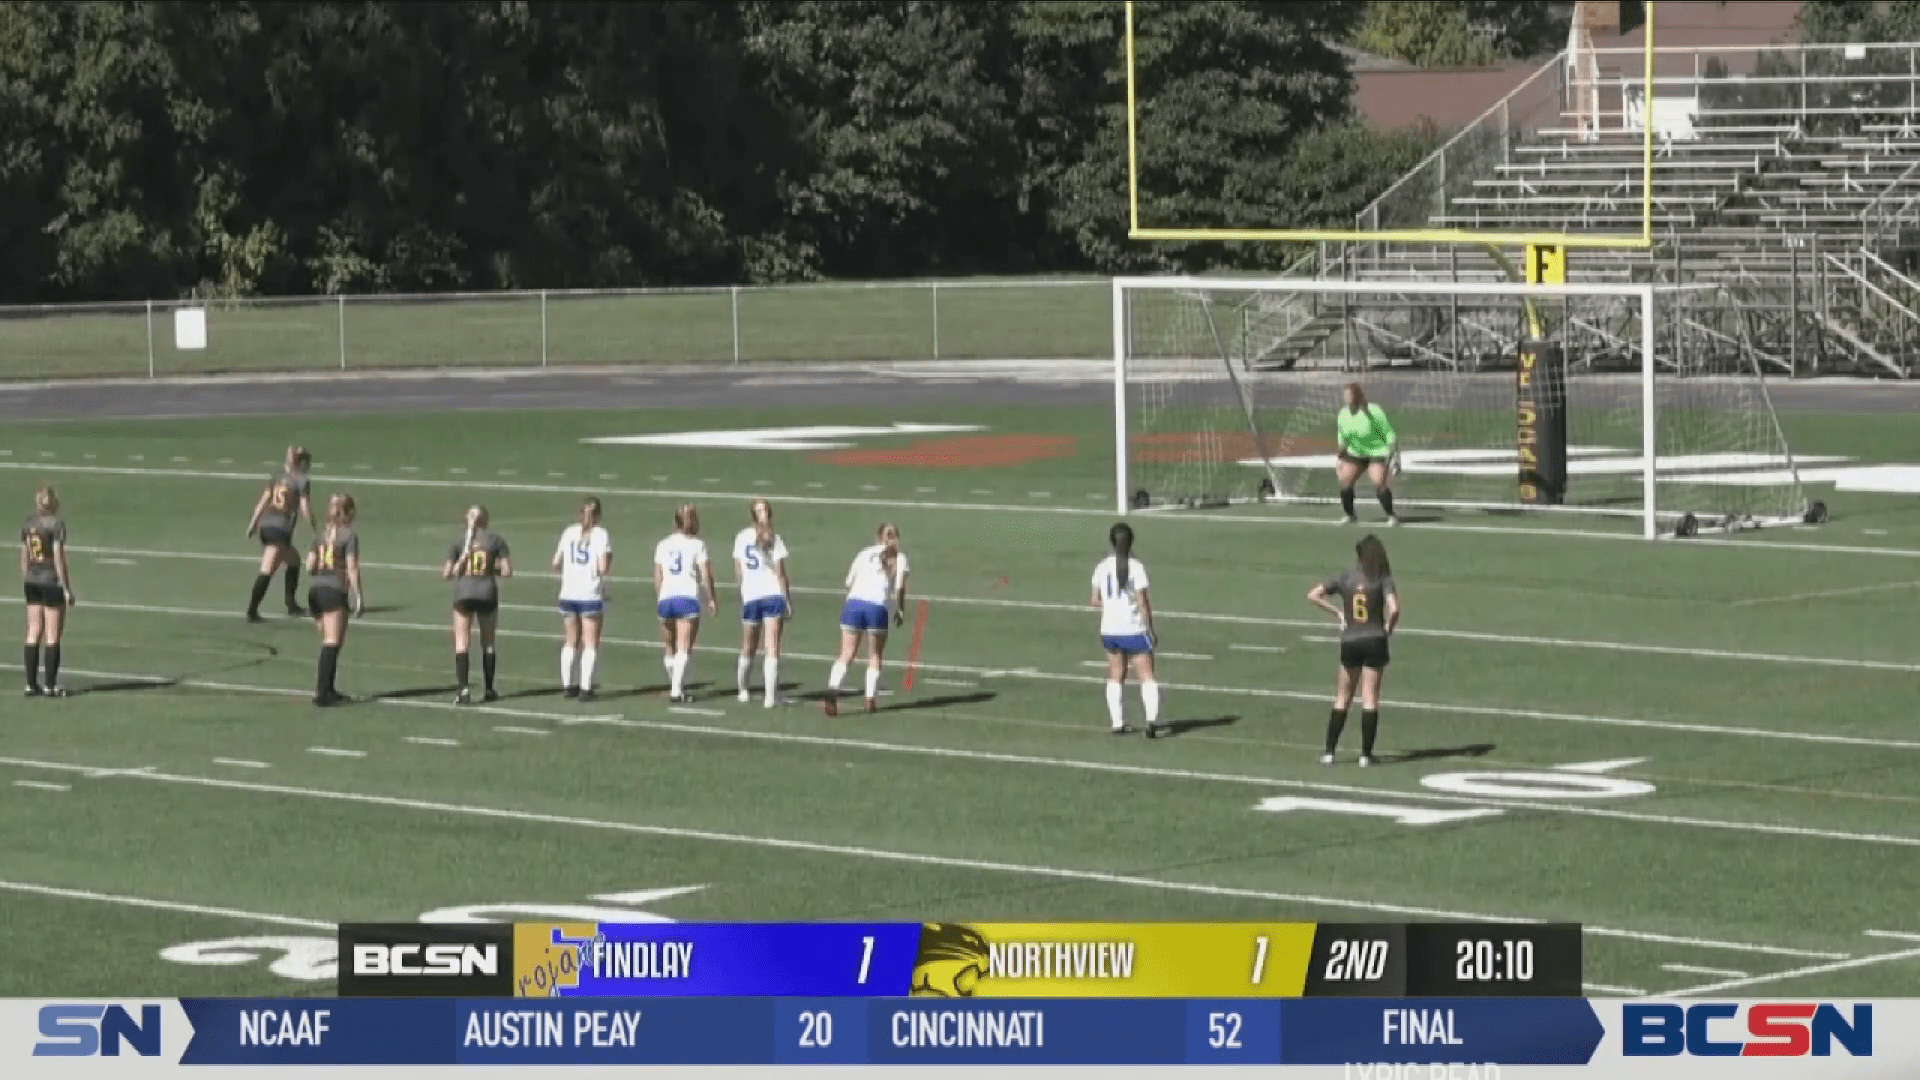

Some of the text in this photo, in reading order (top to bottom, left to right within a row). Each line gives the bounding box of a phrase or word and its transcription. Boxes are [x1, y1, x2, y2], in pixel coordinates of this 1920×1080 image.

[1535, 245, 1556, 283] F
[669, 550, 682, 575] 3
[745, 544, 760, 570] 5
[1352, 594, 1369, 623] 6
